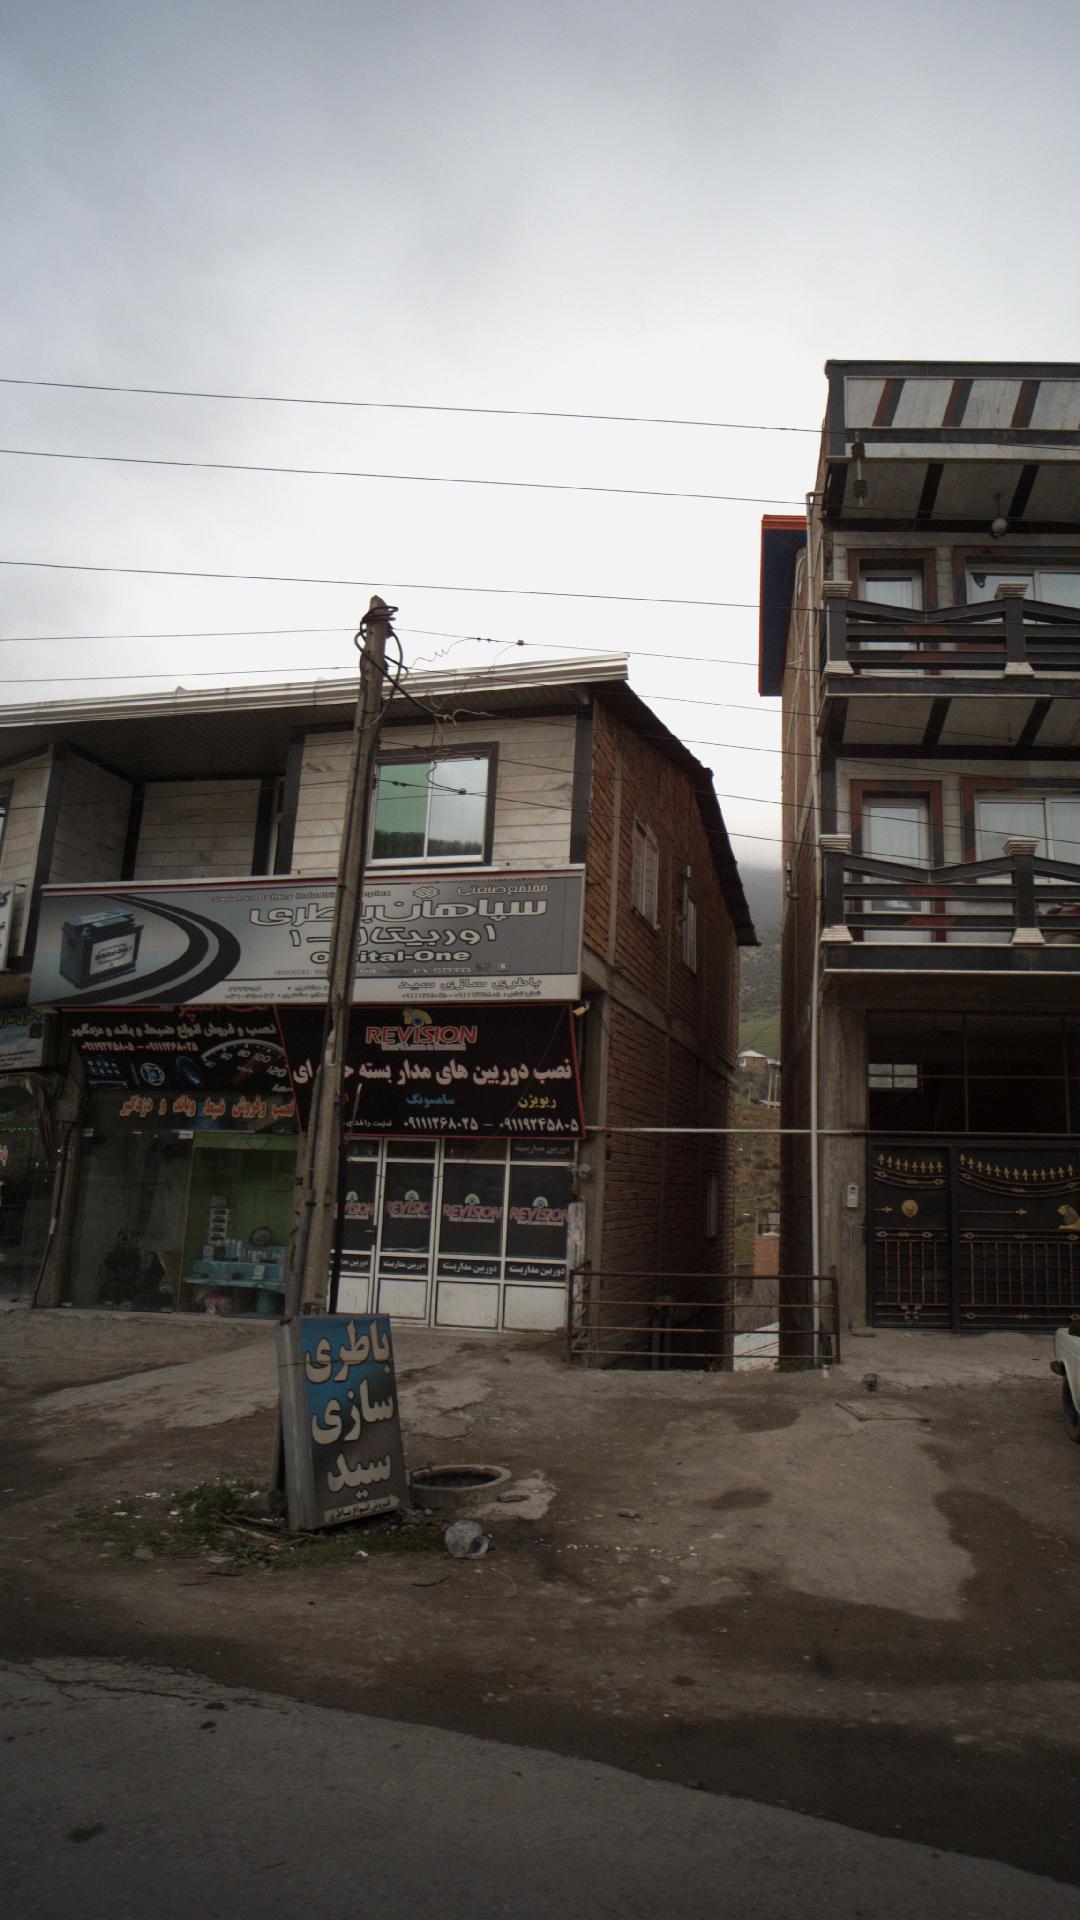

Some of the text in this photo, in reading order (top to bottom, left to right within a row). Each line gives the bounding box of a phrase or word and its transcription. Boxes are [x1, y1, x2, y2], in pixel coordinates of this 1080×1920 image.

[249, 898, 548, 926] سپاهان بطری
[311, 950, 471, 964] Oital-One
[366, 1025, 479, 1045] REVISION
[267, 1065, 288, 1078] 120
[358, 1060, 392, 1084] بسته
[396, 1058, 432, 1086] مدار
[435, 1058, 469, 1086] های
[472, 1062, 529, 1086] دوربین
[533, 1058, 573, 1081] نصب
[403, 1115, 580, 1132] ۰۹۱۱۹۲۴۵۸۰۵ ۰۹۱۱۱۲۶۸۰۲۵
[472, 1264, 498, 1275] دوربین
[539, 1265, 566, 1278] دوربین
[305, 1319, 391, 1383] باطری
[311, 1379, 394, 1445] سازی
[327, 1453, 392, 1499] سید
